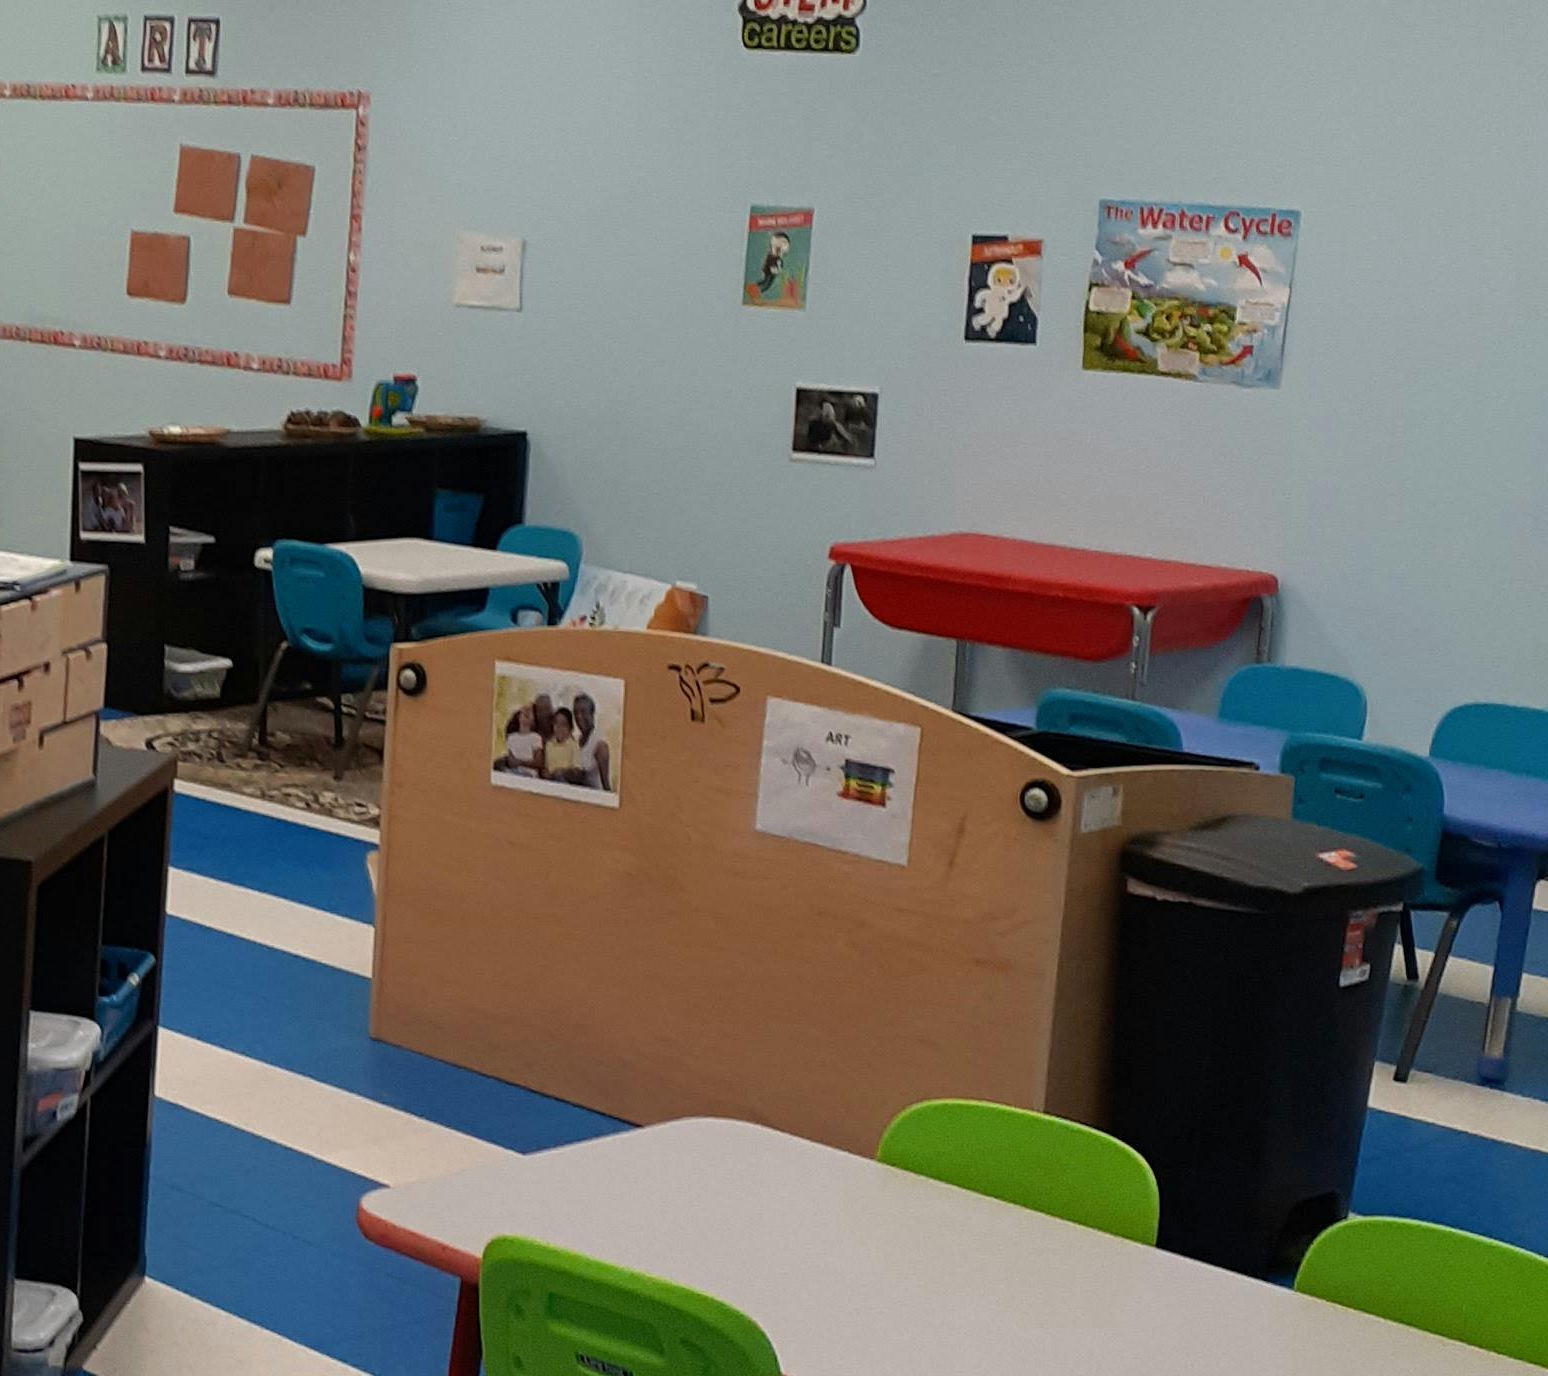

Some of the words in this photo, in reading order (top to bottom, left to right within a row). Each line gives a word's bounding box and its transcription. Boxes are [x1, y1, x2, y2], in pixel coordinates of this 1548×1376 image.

[99, 19, 214, 71] ART
[743, 21, 857, 53] careers
[1105, 205, 1134, 221] The
[1138, 206, 1215, 234] Water
[1223, 210, 1294, 241] Cycle
[825, 730, 852, 747] ART
